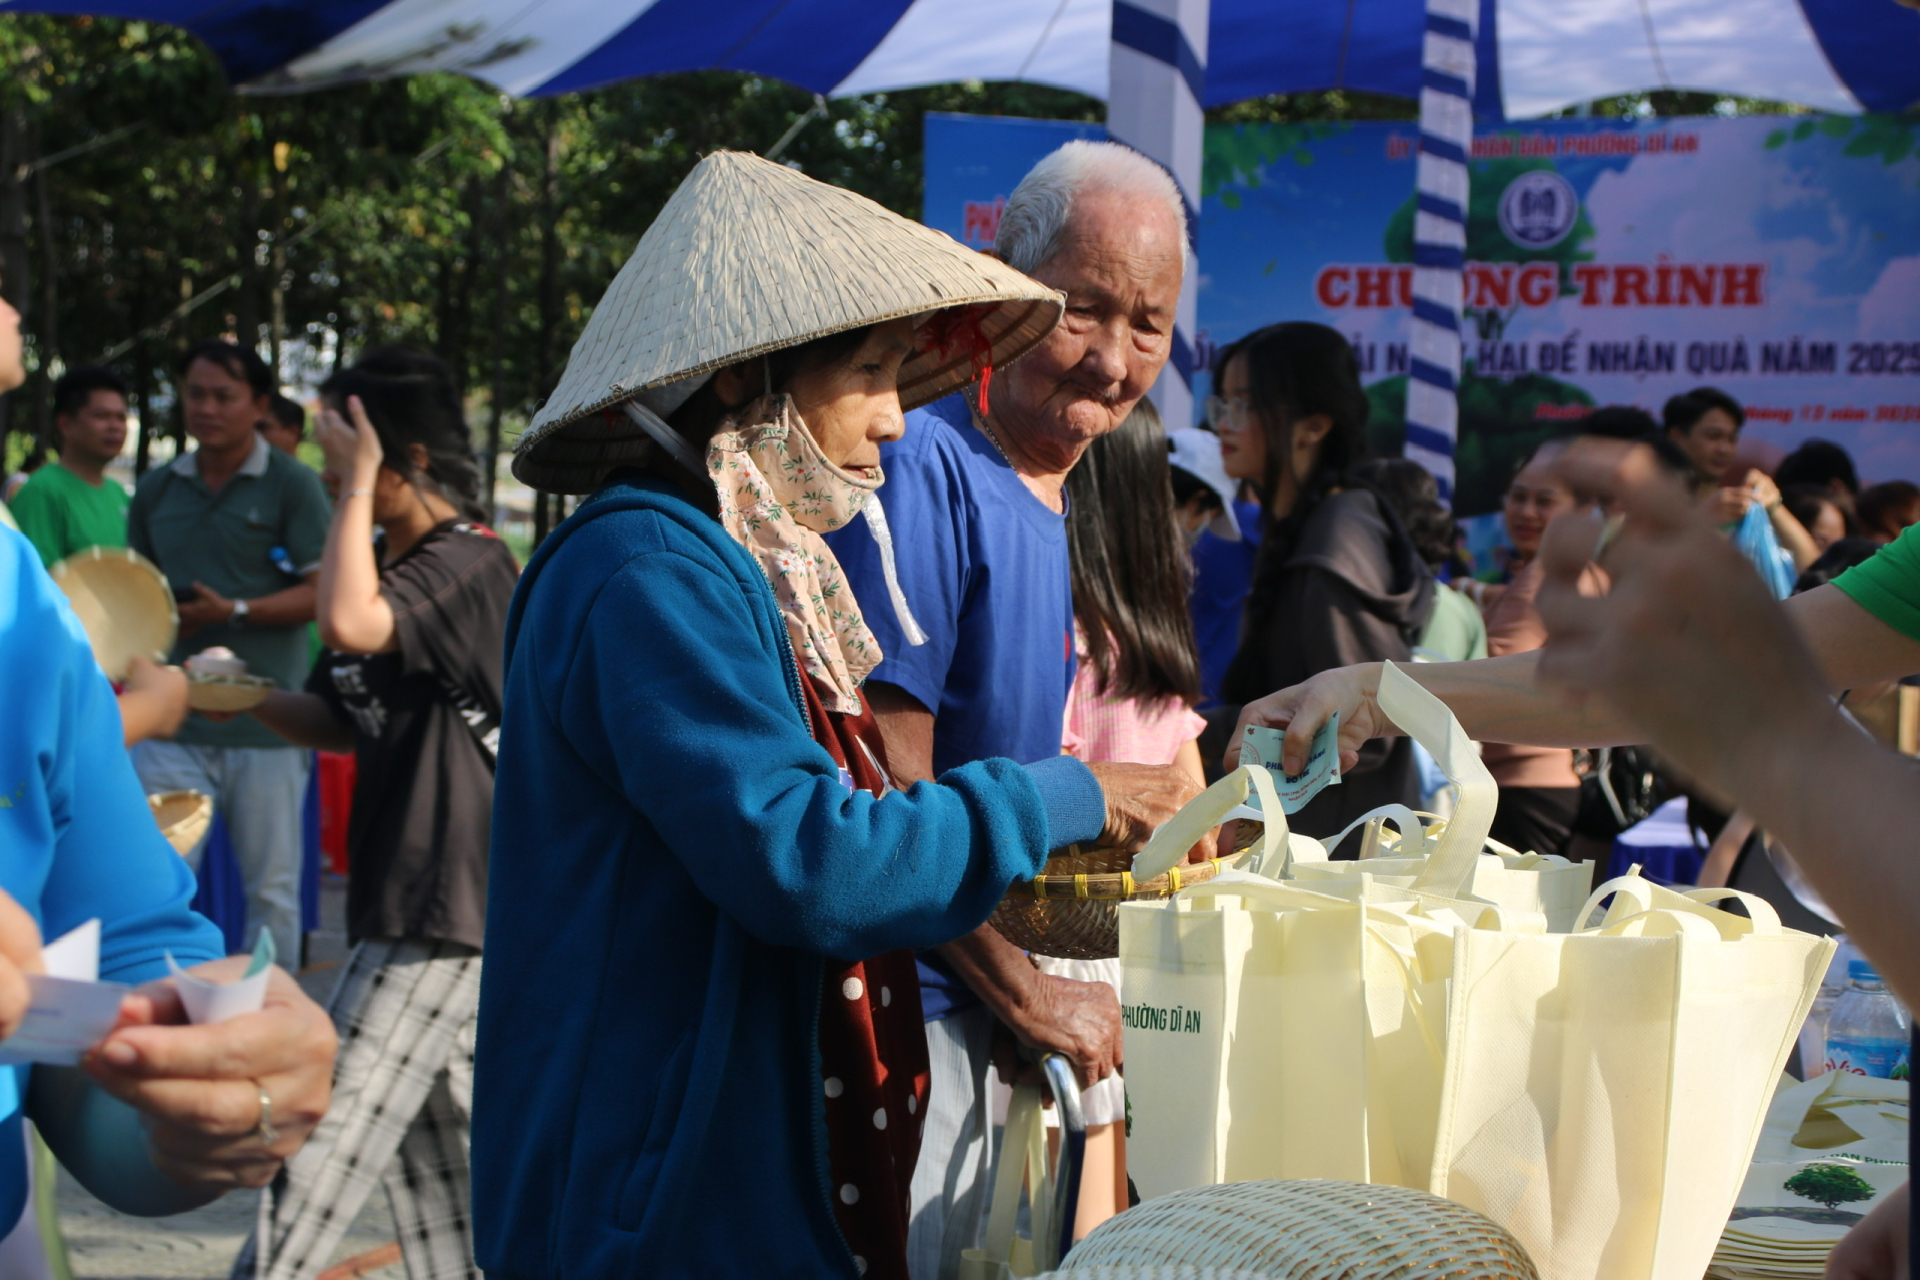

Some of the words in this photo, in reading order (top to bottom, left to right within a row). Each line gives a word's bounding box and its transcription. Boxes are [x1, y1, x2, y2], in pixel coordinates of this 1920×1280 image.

[1317, 263, 1554, 308] CHNG
[1574, 252, 1765, 307] TRÌNH
[1588, 334, 1676, 382] NHẬN
[1687, 336, 1749, 375] QUÀ
[1761, 336, 1836, 375] NĂM
[1121, 1002, 1168, 1031] PHƯỜNG
[1169, 1005, 1183, 1032] DĨ
[1184, 1010, 1201, 1034] AN
